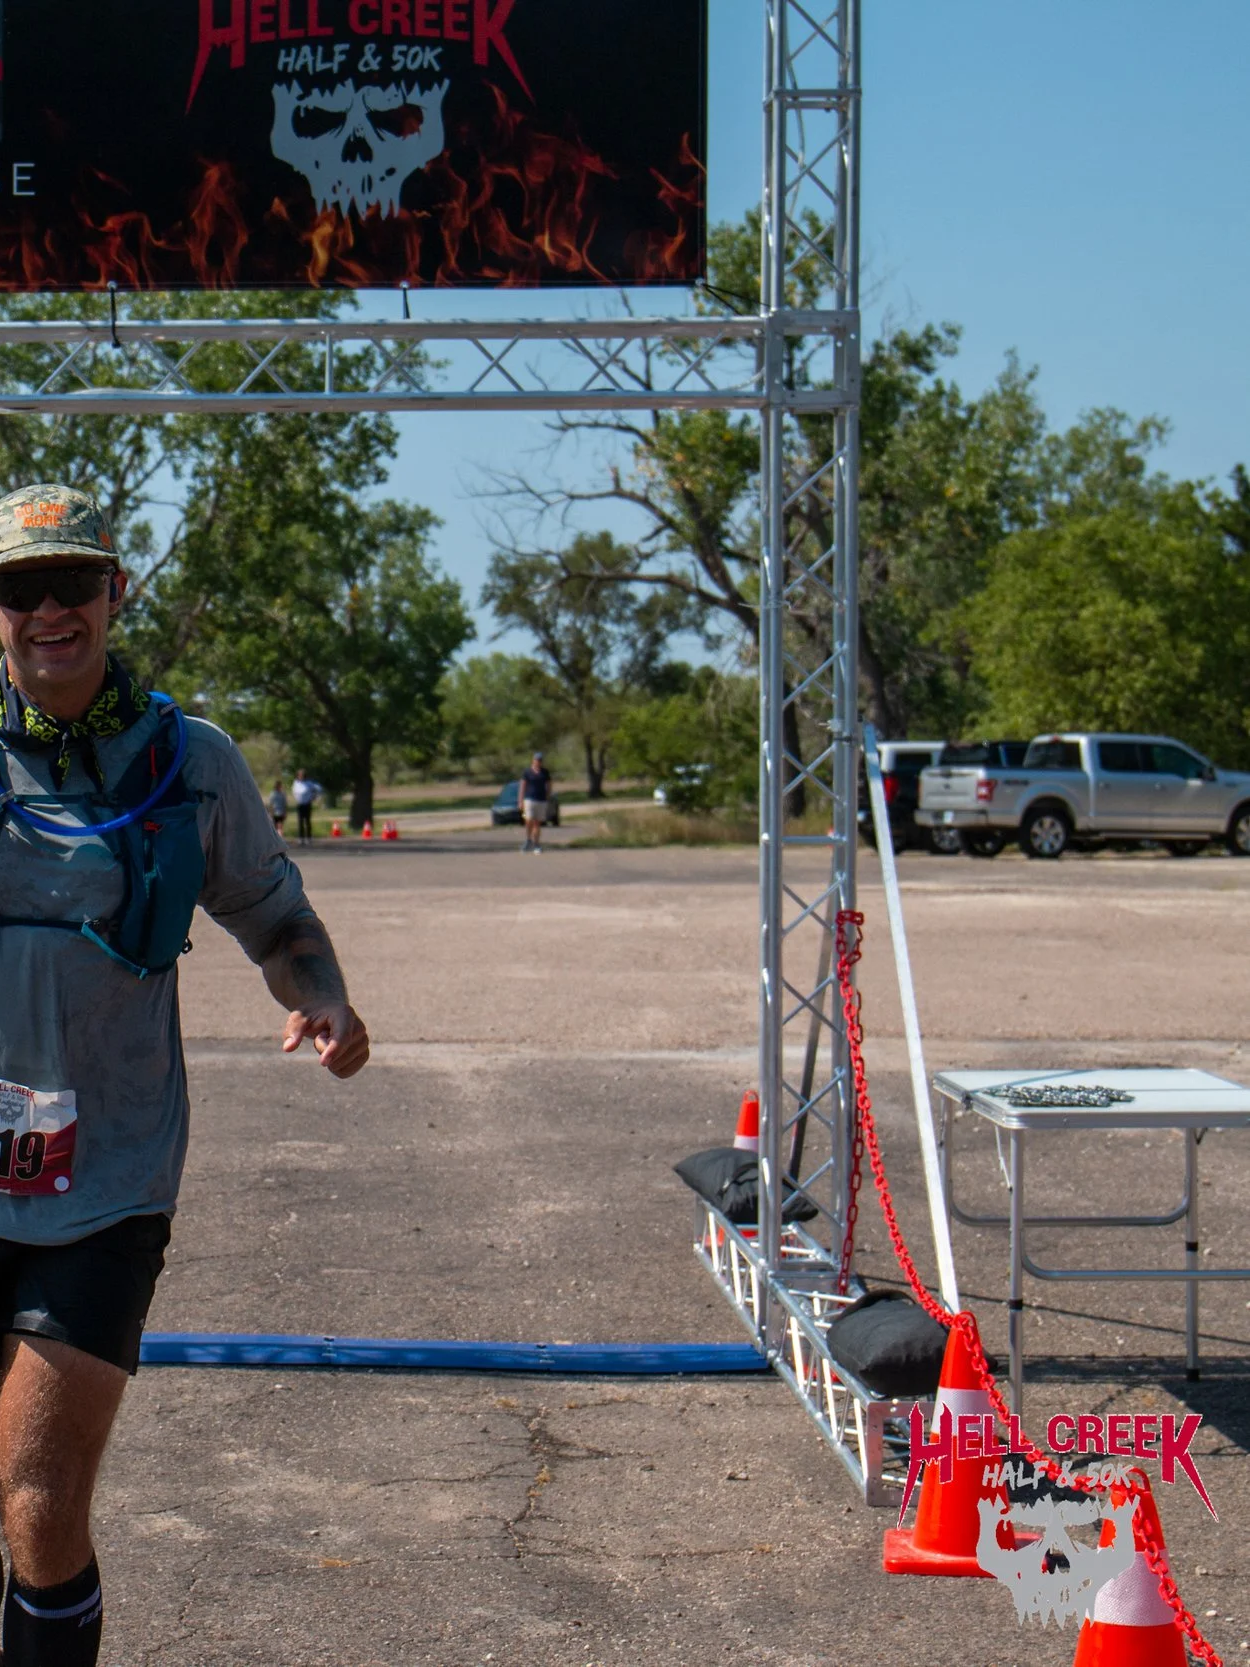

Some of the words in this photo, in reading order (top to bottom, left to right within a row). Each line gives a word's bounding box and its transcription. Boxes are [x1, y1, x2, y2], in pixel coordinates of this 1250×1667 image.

[185, 0, 335, 114] HELL
[349, 0, 536, 105] CREEK
[277, 43, 350, 73] HALF
[358, 44, 381, 72] &
[390, 44, 443, 72] 50K
